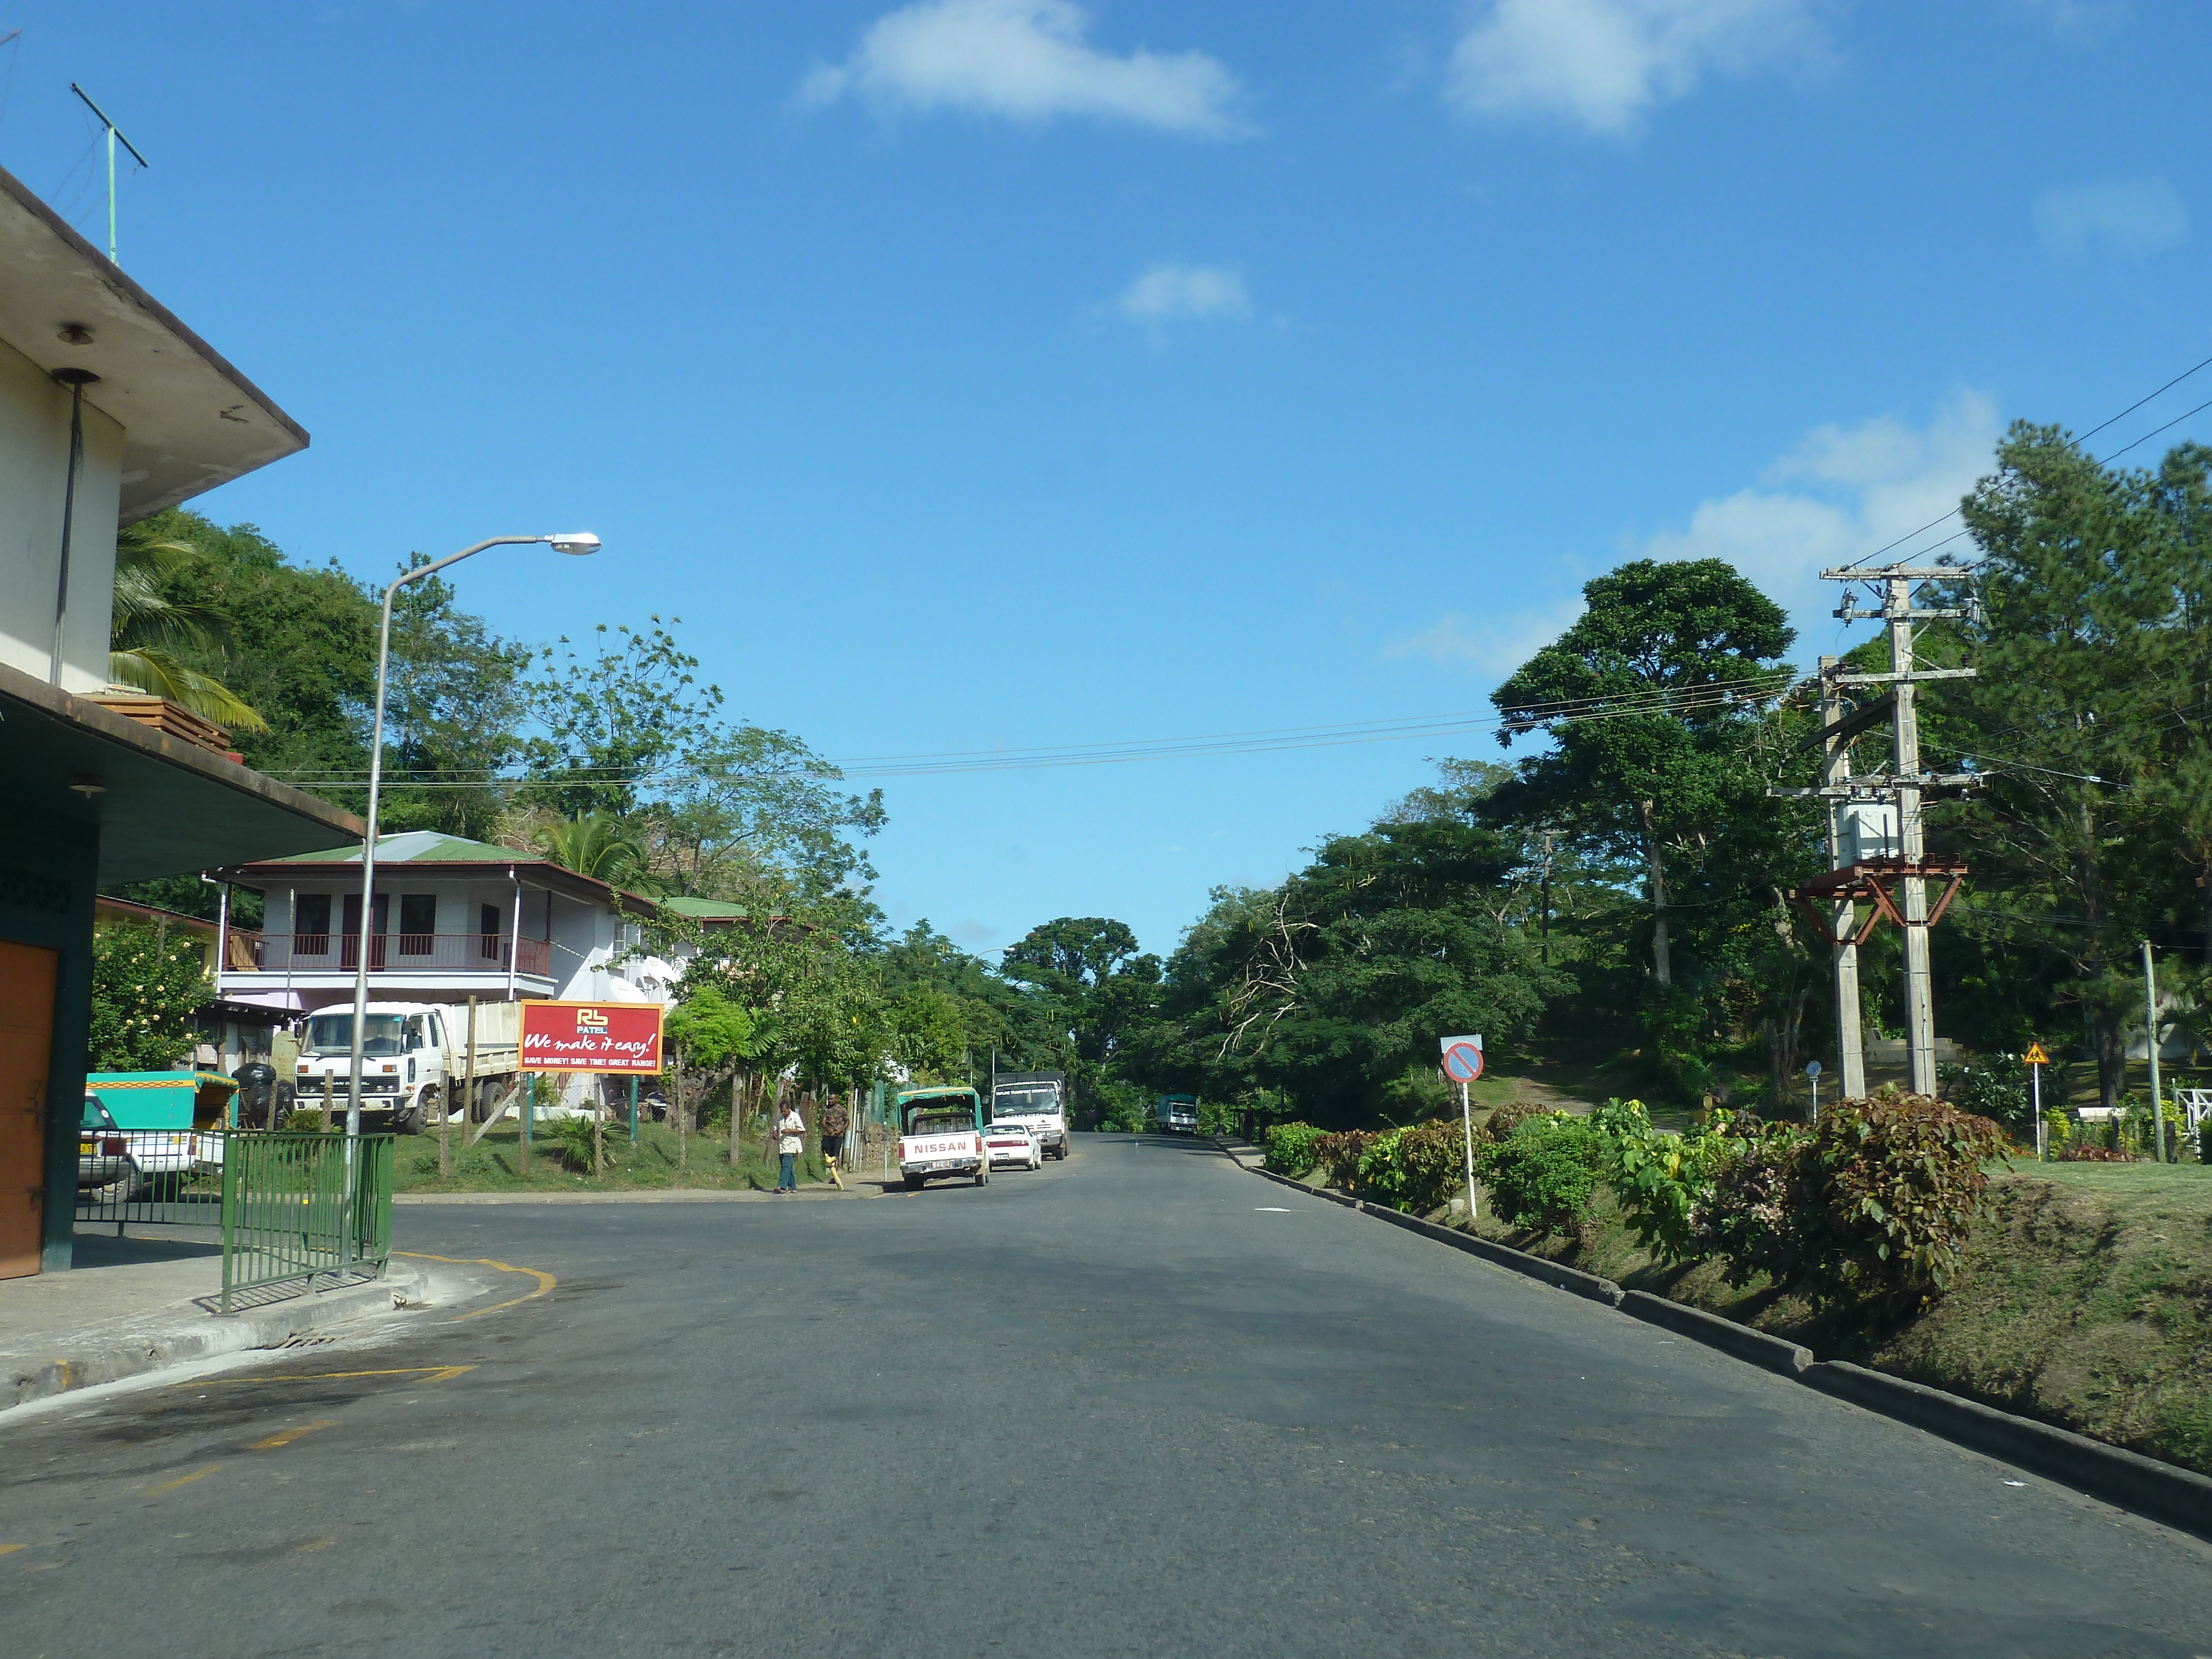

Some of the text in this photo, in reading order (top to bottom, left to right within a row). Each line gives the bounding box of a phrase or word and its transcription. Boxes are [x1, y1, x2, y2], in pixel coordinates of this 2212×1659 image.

[524, 1033, 656, 1058] We make it easy!
[915, 1142, 966, 1154] NISSAN
